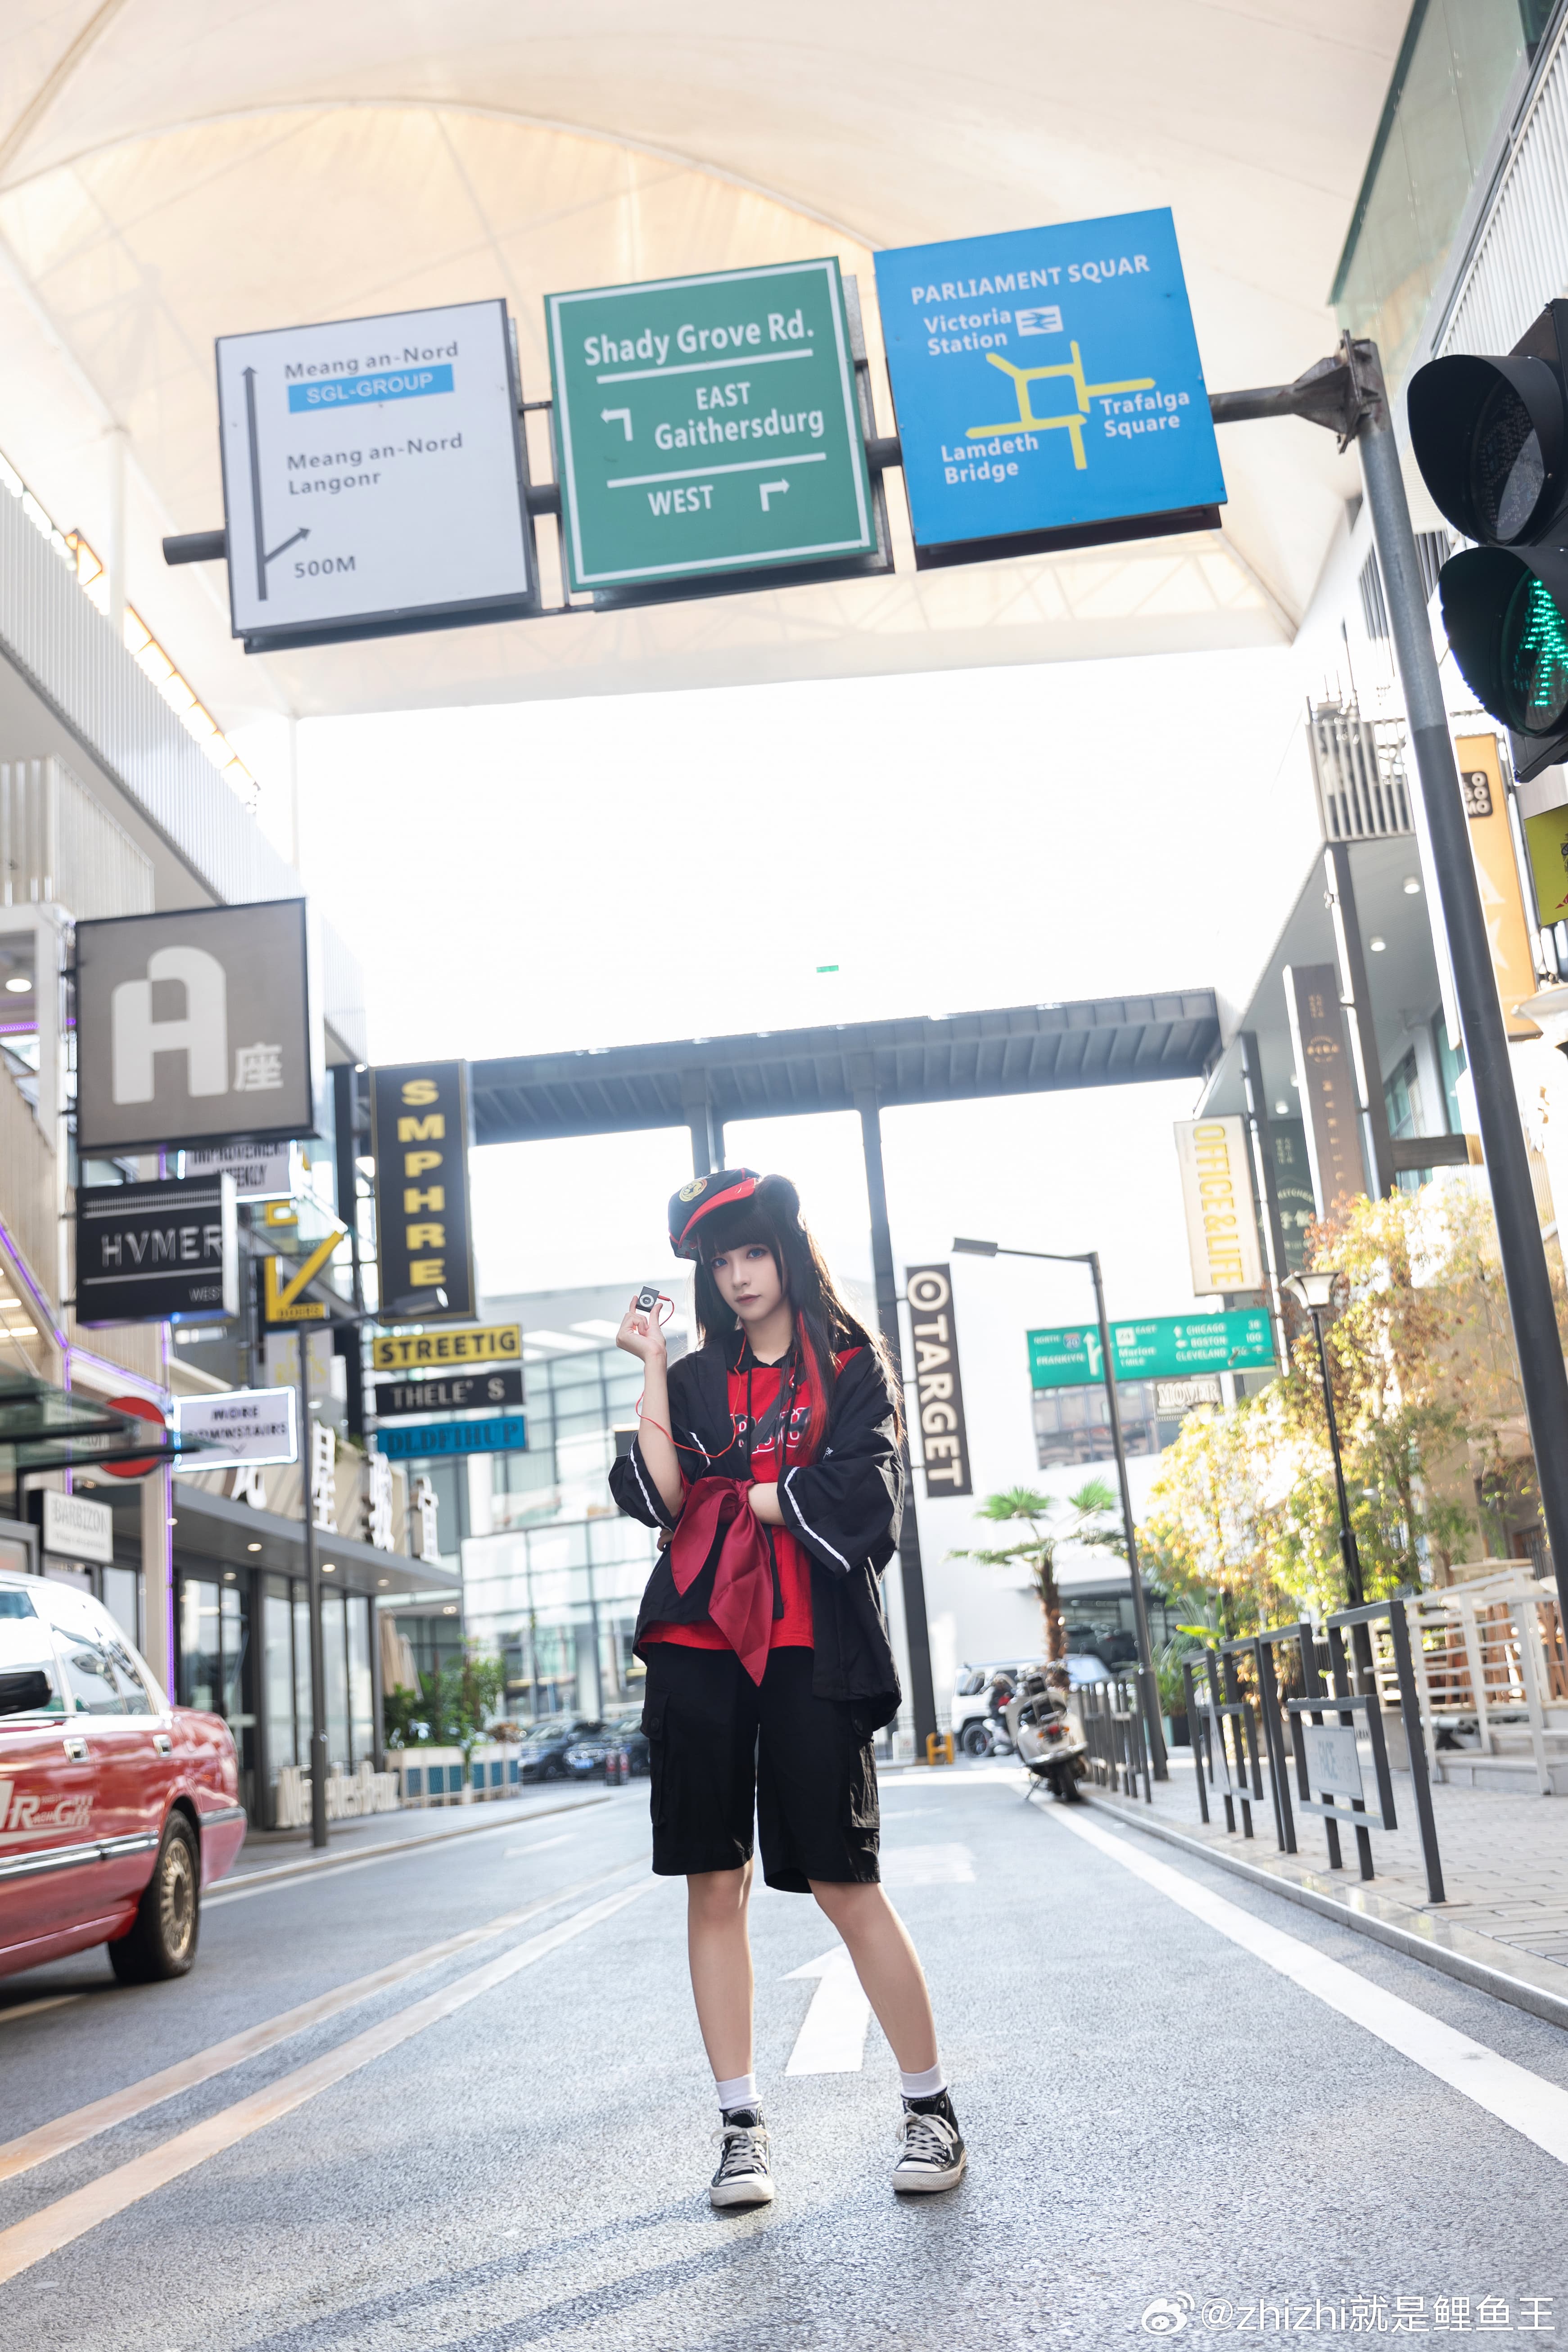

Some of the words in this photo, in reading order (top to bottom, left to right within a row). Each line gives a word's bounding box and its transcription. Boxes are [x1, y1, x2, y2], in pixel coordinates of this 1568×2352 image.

[911, 267, 1062, 305] PARLIAMENT
[1068, 254, 1150, 284] SQUAR
[924, 307, 1012, 334] Victoria
[584, 329, 670, 366] Shady
[677, 321, 761, 353] Grove
[768, 309, 814, 342] Rd.
[928, 331, 1008, 356] Station
[306, 372, 434, 404] SGL-GROUP
[696, 382, 751, 411] EAST
[1099, 391, 1190, 416] Trafalga
[654, 408, 824, 450] Gaithersdurg
[1105, 414, 1180, 439] Square
[941, 433, 1039, 463] Lamdeth
[289, 471, 382, 496] Langonr
[945, 460, 1019, 485] Bridge
[648, 485, 714, 516] WEST
[294, 555, 356, 578] 500M
[398, 1079, 446, 1287] SMPHRE
[380, 1332, 516, 1363] STREETIG
